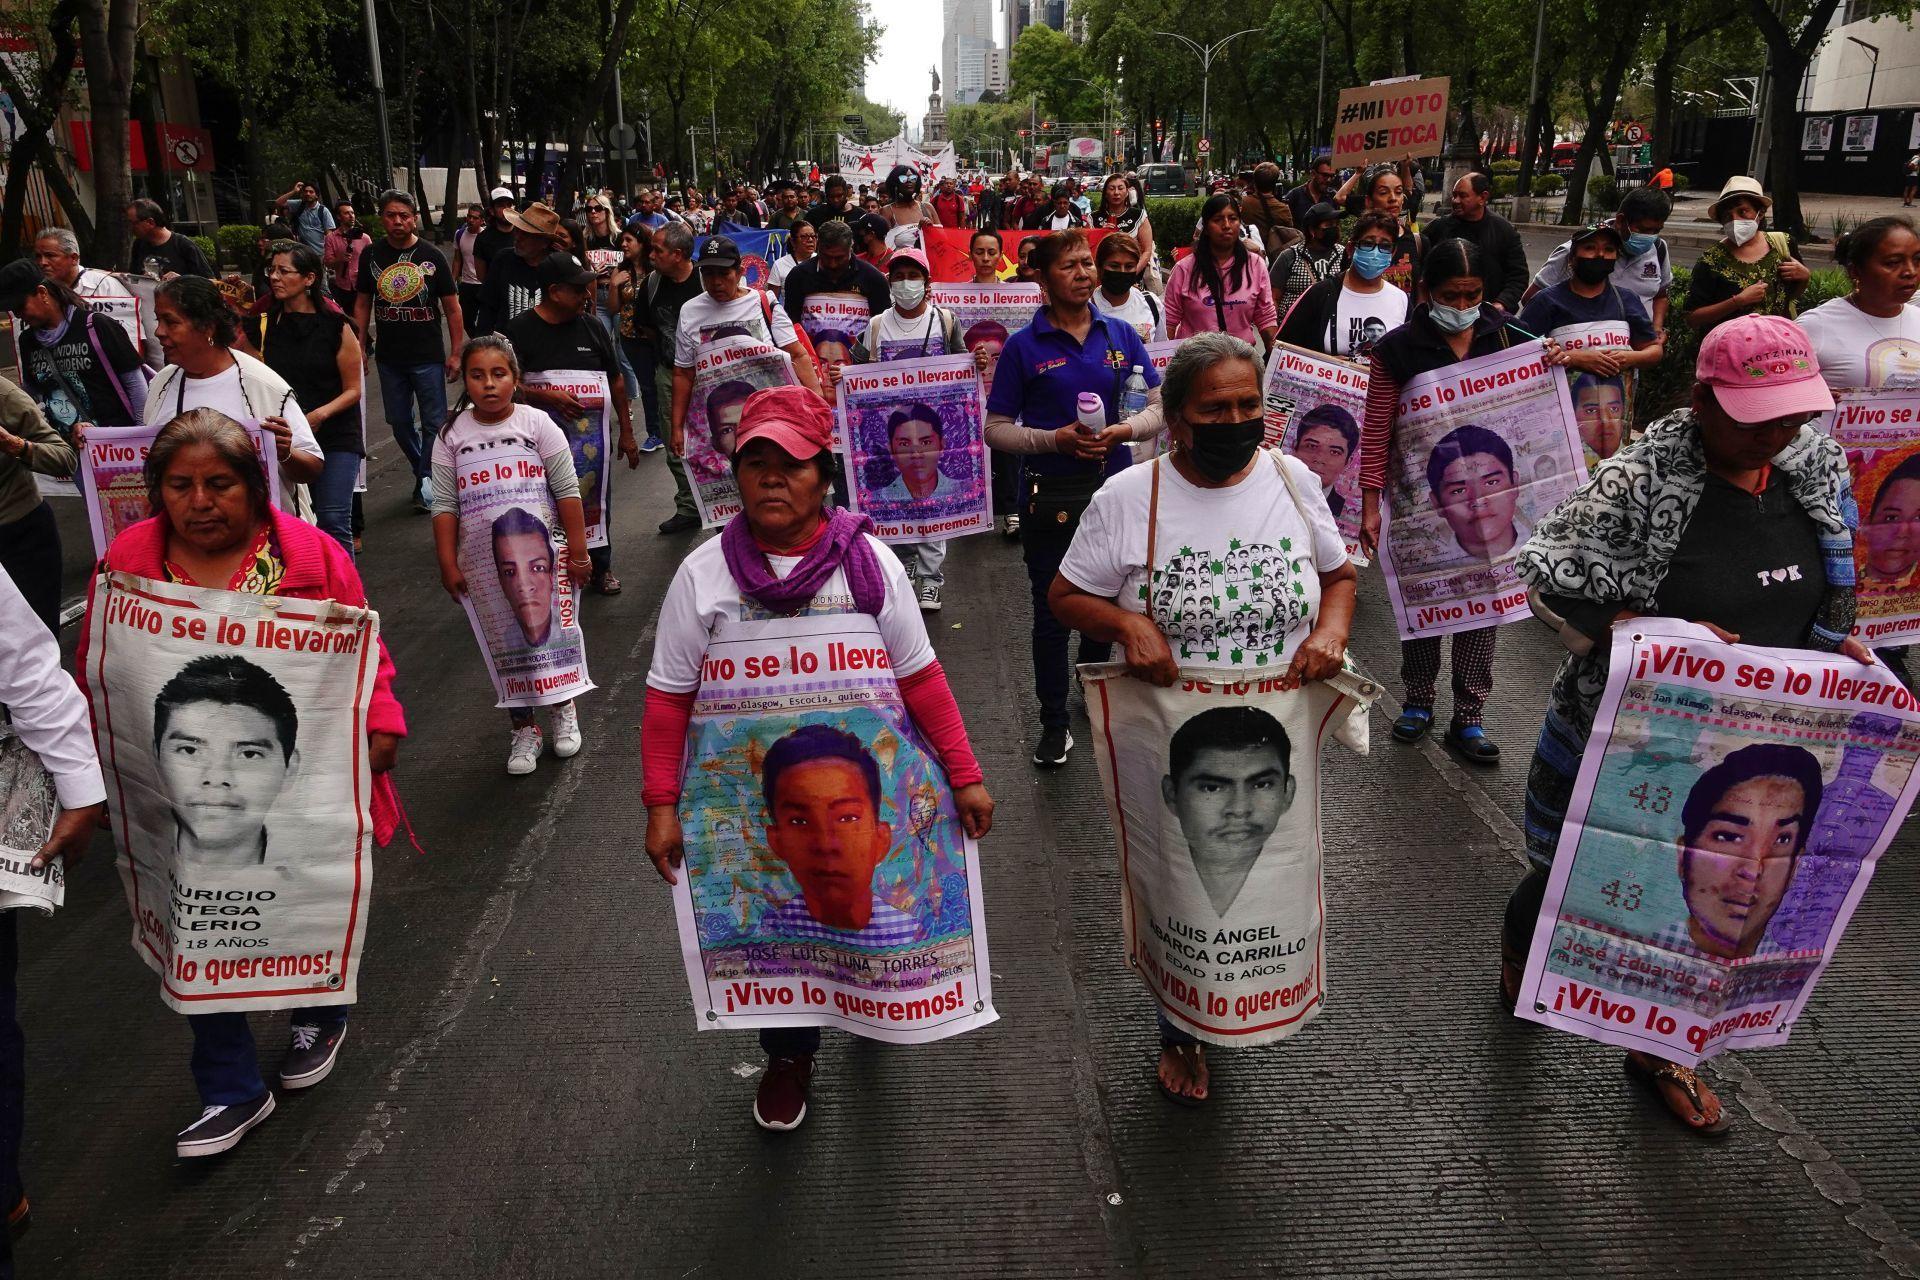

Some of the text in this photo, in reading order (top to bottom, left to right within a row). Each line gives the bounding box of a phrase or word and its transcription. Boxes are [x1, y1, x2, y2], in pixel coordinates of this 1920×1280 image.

[1341, 93, 1443, 124] #MIVOTO
[1336, 123, 1437, 154] NOSETOCA
[810, 304, 822, 314] se
[826, 302, 836, 314] lo
[932, 292, 1043, 305] ¡Vivo se lo llevaron!
[1349, 317, 1363, 330] VI
[57, 342, 89, 357] NTONIO
[1565, 338, 1584, 351] se
[1588, 334, 1602, 347] lo
[697, 358, 708, 372] se
[710, 353, 723, 367] lo
[1278, 354, 1314, 375] ¡Vivo
[1317, 367, 1333, 380] se
[1336, 369, 1349, 385] lo
[1352, 374, 1368, 391] lle
[1742, 349, 1809, 368] AYOTZINAPA
[1775, 365, 1786, 373] 43
[846, 377, 880, 395] ¡Vivo
[883, 376, 899, 388] se
[902, 372, 915, 385] lo
[918, 365, 976, 384] llevaron!
[1411, 354, 1550, 413] se lo llevaron!
[1266, 396, 1296, 414] 43
[1836, 406, 1912, 429] ¡Vivo se
[92, 443, 135, 467] ¡Vivo
[470, 460, 547, 486] se lo llev
[712, 504, 741, 520] ¡Vivo
[873, 513, 980, 537] Vivo lo queremos!
[1405, 576, 1461, 595] CHRISTIAN
[109, 596, 361, 655] ¡Vivo se lo llevaron!
[559, 600, 574, 628] NOS
[1417, 606, 1463, 629] ¡Vivo
[1466, 600, 1487, 616] lo
[702, 652, 736, 682] ivo
[744, 655, 780, 680] se
[789, 645, 819, 676] lo
[1636, 643, 1726, 683] ¡Vivo
[1734, 662, 1776, 690] se
[1782, 665, 1813, 696] lo
[506, 677, 526, 698] ¡Vivo
[535, 667, 580, 695] queremos!
[741, 699, 784, 710] Glasgow,
[789, 695, 833, 707] Escocia,
[838, 691, 871, 703] quiero
[1629, 689, 1645, 701] Yo,
[1653, 693, 1671, 705] Jan
[1677, 696, 1714, 714] Nimmo,
[1720, 705, 1766, 721] Glasgow,
[1771, 713, 1813, 728] Escocia,
[1628, 781, 1672, 815] 43
[1601, 879, 1644, 912] 43
[186, 936, 270, 950] 18 AÑOS
[1150, 918, 1307, 966] ABARCA CARRILLO
[1168, 916, 1281, 946] LUIS ÁNGEL
[175, 954, 198, 983] lo
[204, 950, 334, 986] queremos!
[715, 967, 739, 979] Hijo
[759, 967, 810, 976] Macedonia
[930, 964, 964, 982] MORELOS
[743, 945, 781, 962] JOSÉ
[835, 956, 872, 974] LUNA
[881, 951, 939, 974] TORRES
[1165, 951, 1287, 982] EDAD 18 AÑOS
[1557, 952, 1583, 967] Hijo
[1562, 936, 1607, 962] José
[1617, 952, 1698, 987] Eduardo
[725, 981, 965, 1022] ¡Vivo lo queremos!
[1160, 963, 1315, 1022] VIDA lo queremos!
[1553, 981, 1637, 1025] ¡Vivo
[1645, 1004, 1677, 1037] lo
